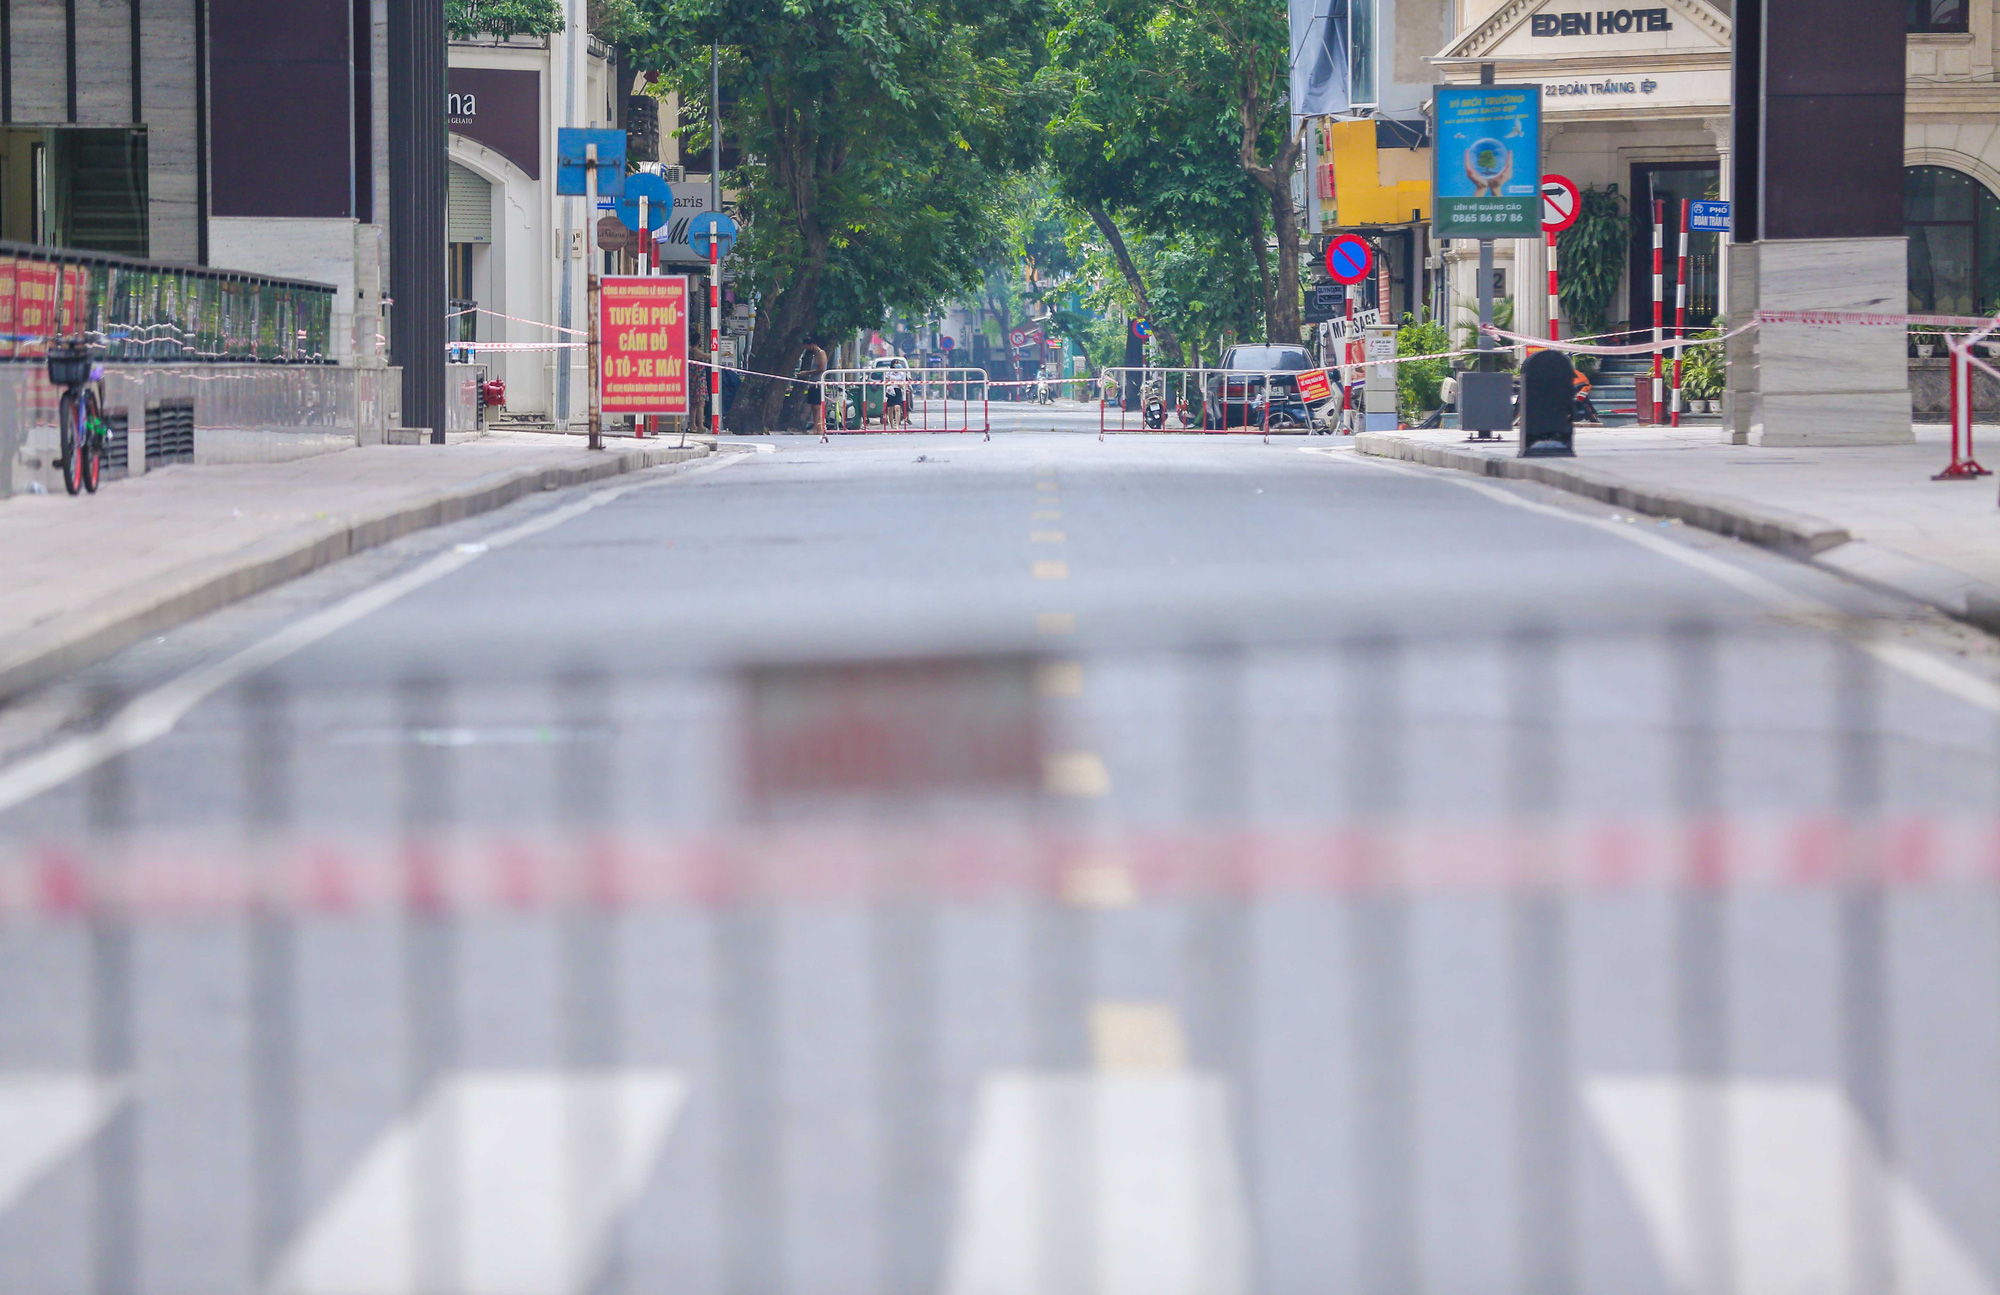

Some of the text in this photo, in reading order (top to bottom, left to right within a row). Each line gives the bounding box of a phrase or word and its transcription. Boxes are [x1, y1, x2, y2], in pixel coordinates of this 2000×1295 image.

[1531, 8, 1673, 37] EDEN HOTEL
[1545, 85, 1557, 96] 22
[1558, 81, 1588, 95] ĐOÀN
[448, 93, 476, 115] na
[1461, 96, 1482, 107] MÔI
[673, 196, 703, 208] aris
[1453, 203, 1522, 212] LIÊN HỆ QUẢNG CÁO
[1709, 204, 1727, 214] PHỐ
[1452, 213, 1523, 222] 0865 86 87 86
[609, 301, 677, 325] TUYẾN PHỐ
[1332, 313, 1376, 339] MASAGE
[619, 327, 668, 351] CẤM ĐỖ
[605, 355, 614, 377] Ô
[616, 355, 631, 377] TÔ
[638, 359, 653, 377] XE
[655, 355, 682, 377] MÁY
